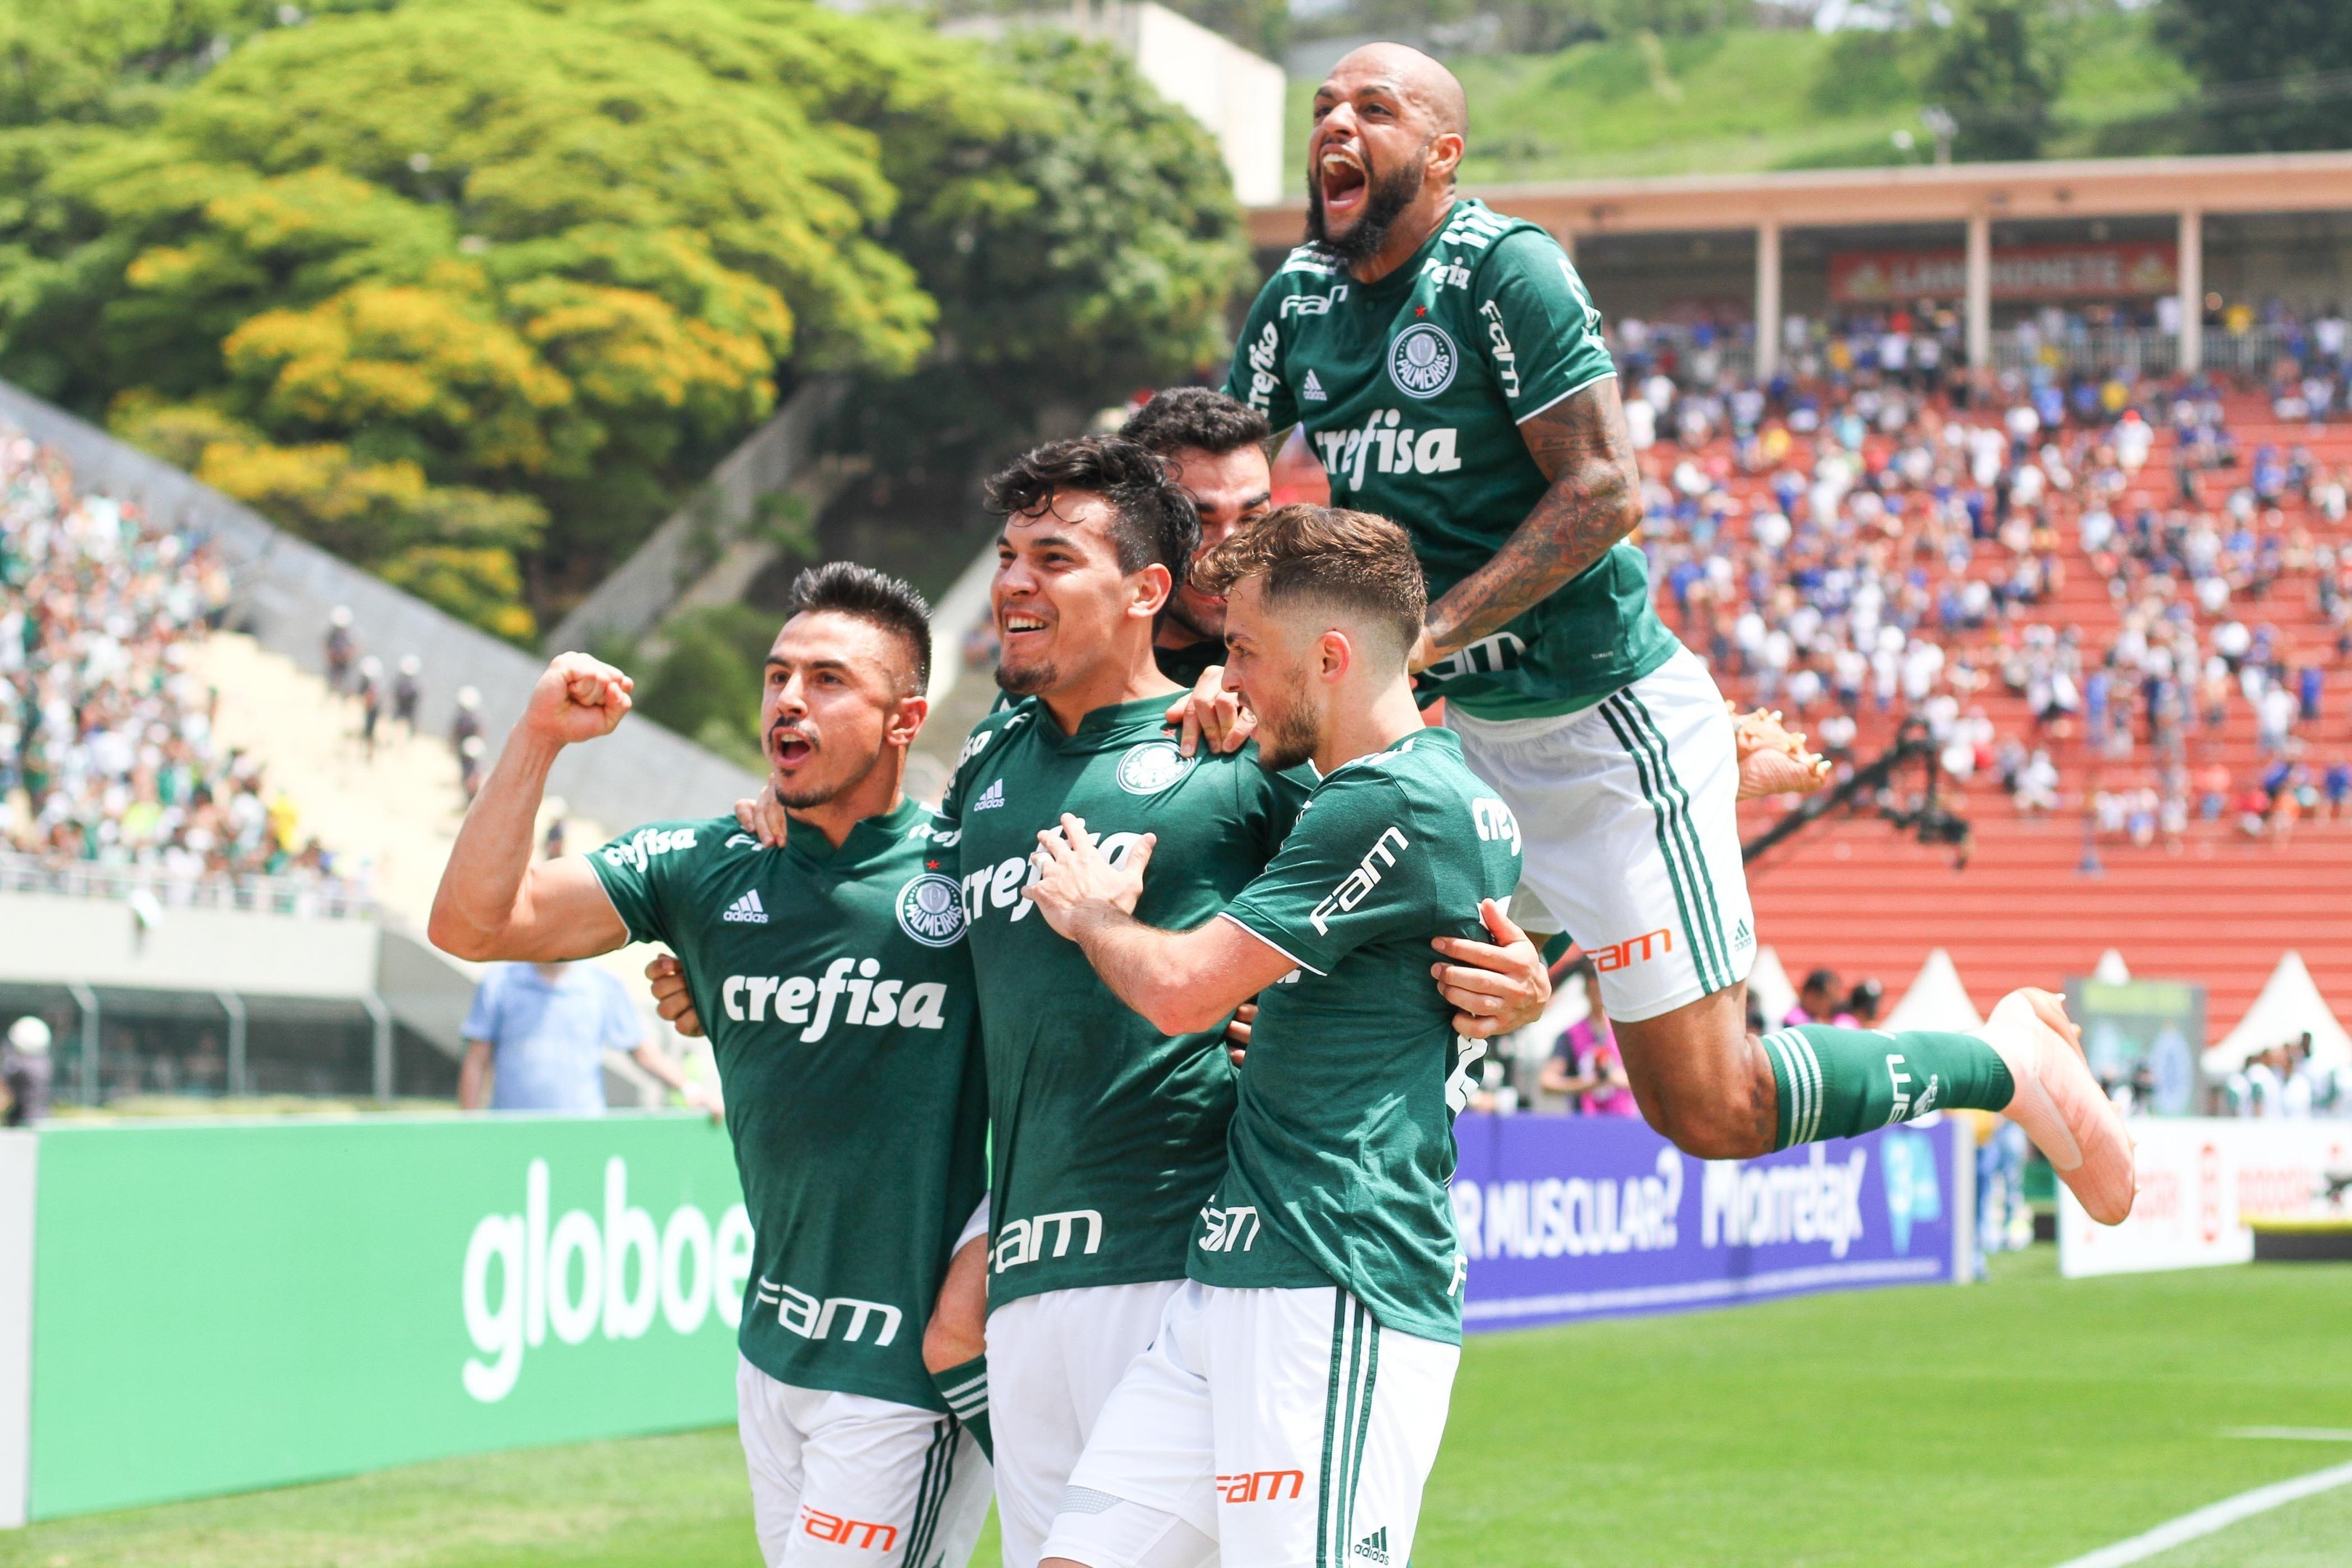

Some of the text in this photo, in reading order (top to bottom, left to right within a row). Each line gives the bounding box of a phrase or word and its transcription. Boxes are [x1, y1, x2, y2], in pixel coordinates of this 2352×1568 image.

[1396, 354, 1450, 390] PALMEIRAS
[1423, 632, 1527, 681] am
[973, 797, 1005, 812] adidas
[723, 910, 769, 924] adidas
[905, 905, 963, 937] PALMEIRAS
[722, 957, 947, 1043] crefisa
[987, 1209, 1103, 1285] am
[1354, 1542, 1389, 1566] adidas
